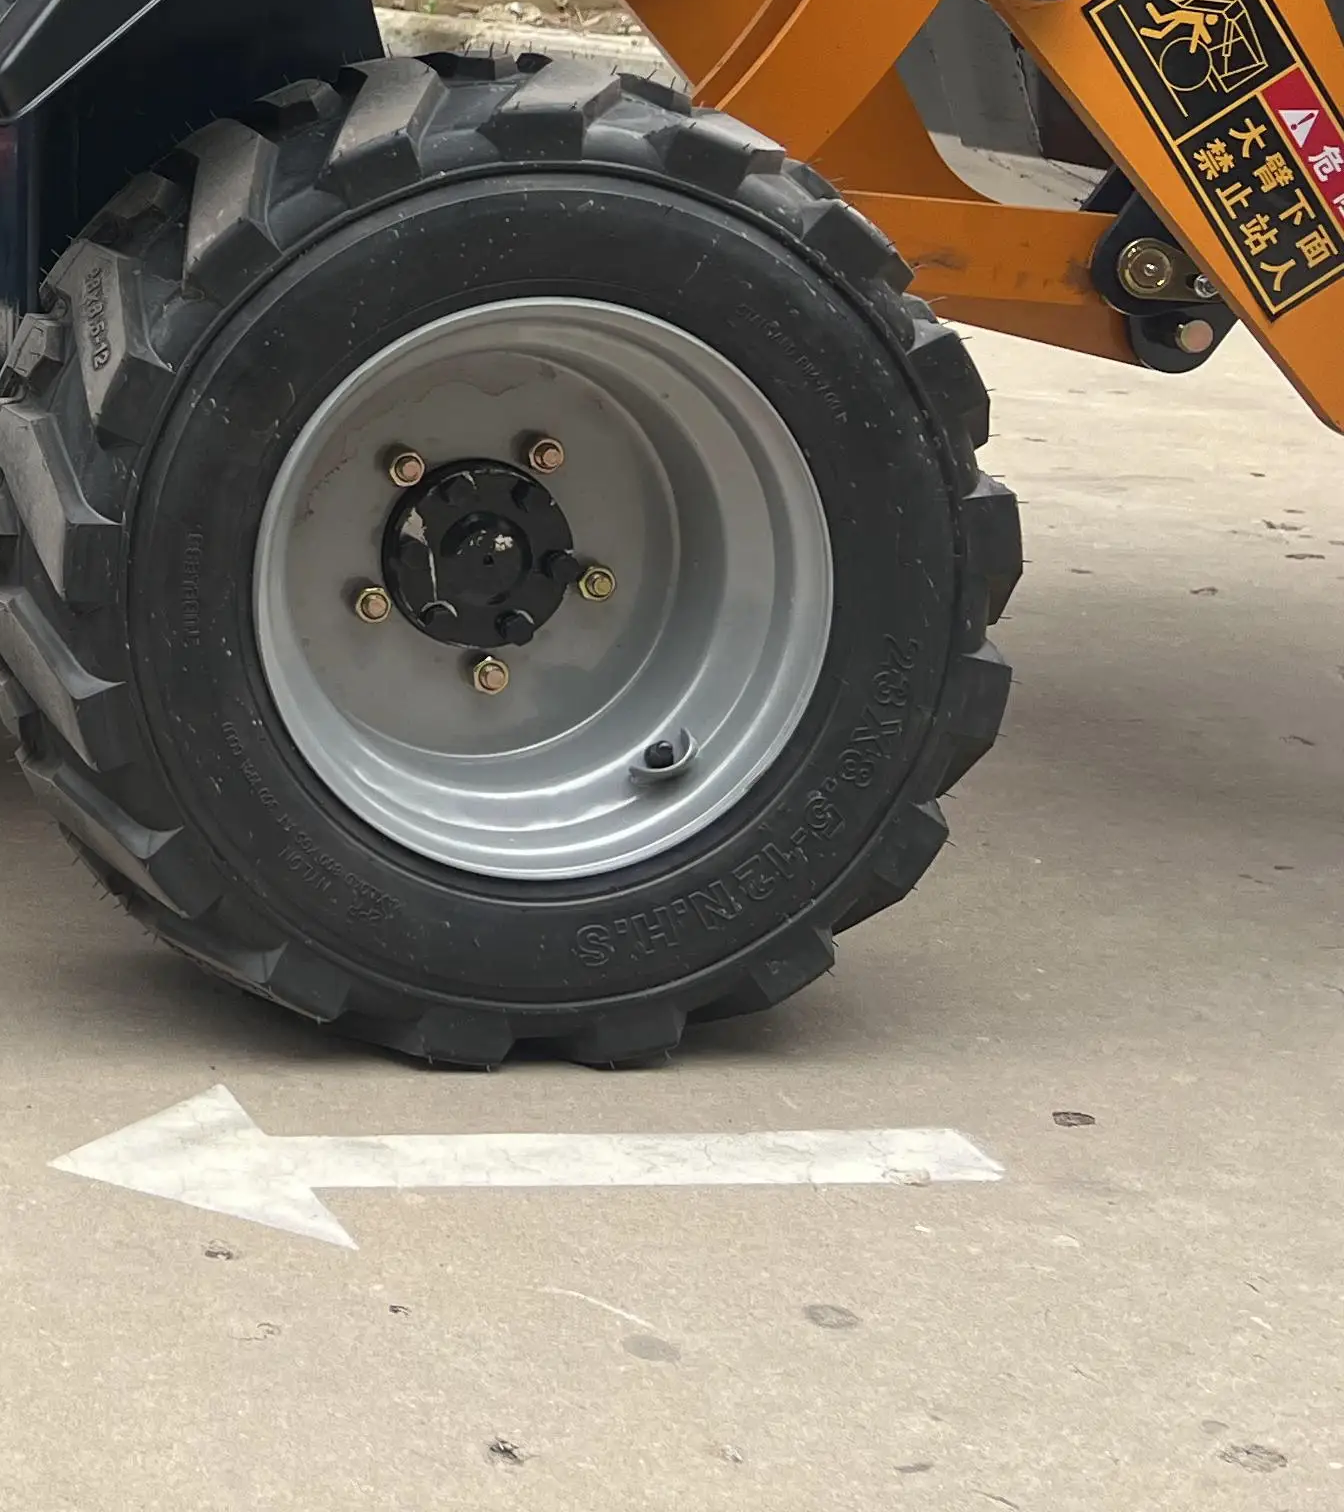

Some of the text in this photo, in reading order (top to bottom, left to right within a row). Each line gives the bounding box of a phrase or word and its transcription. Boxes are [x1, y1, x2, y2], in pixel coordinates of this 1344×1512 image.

[1193, 138, 1295, 293] 禁止站人
[1229, 118, 1339, 268] 大臂下面
